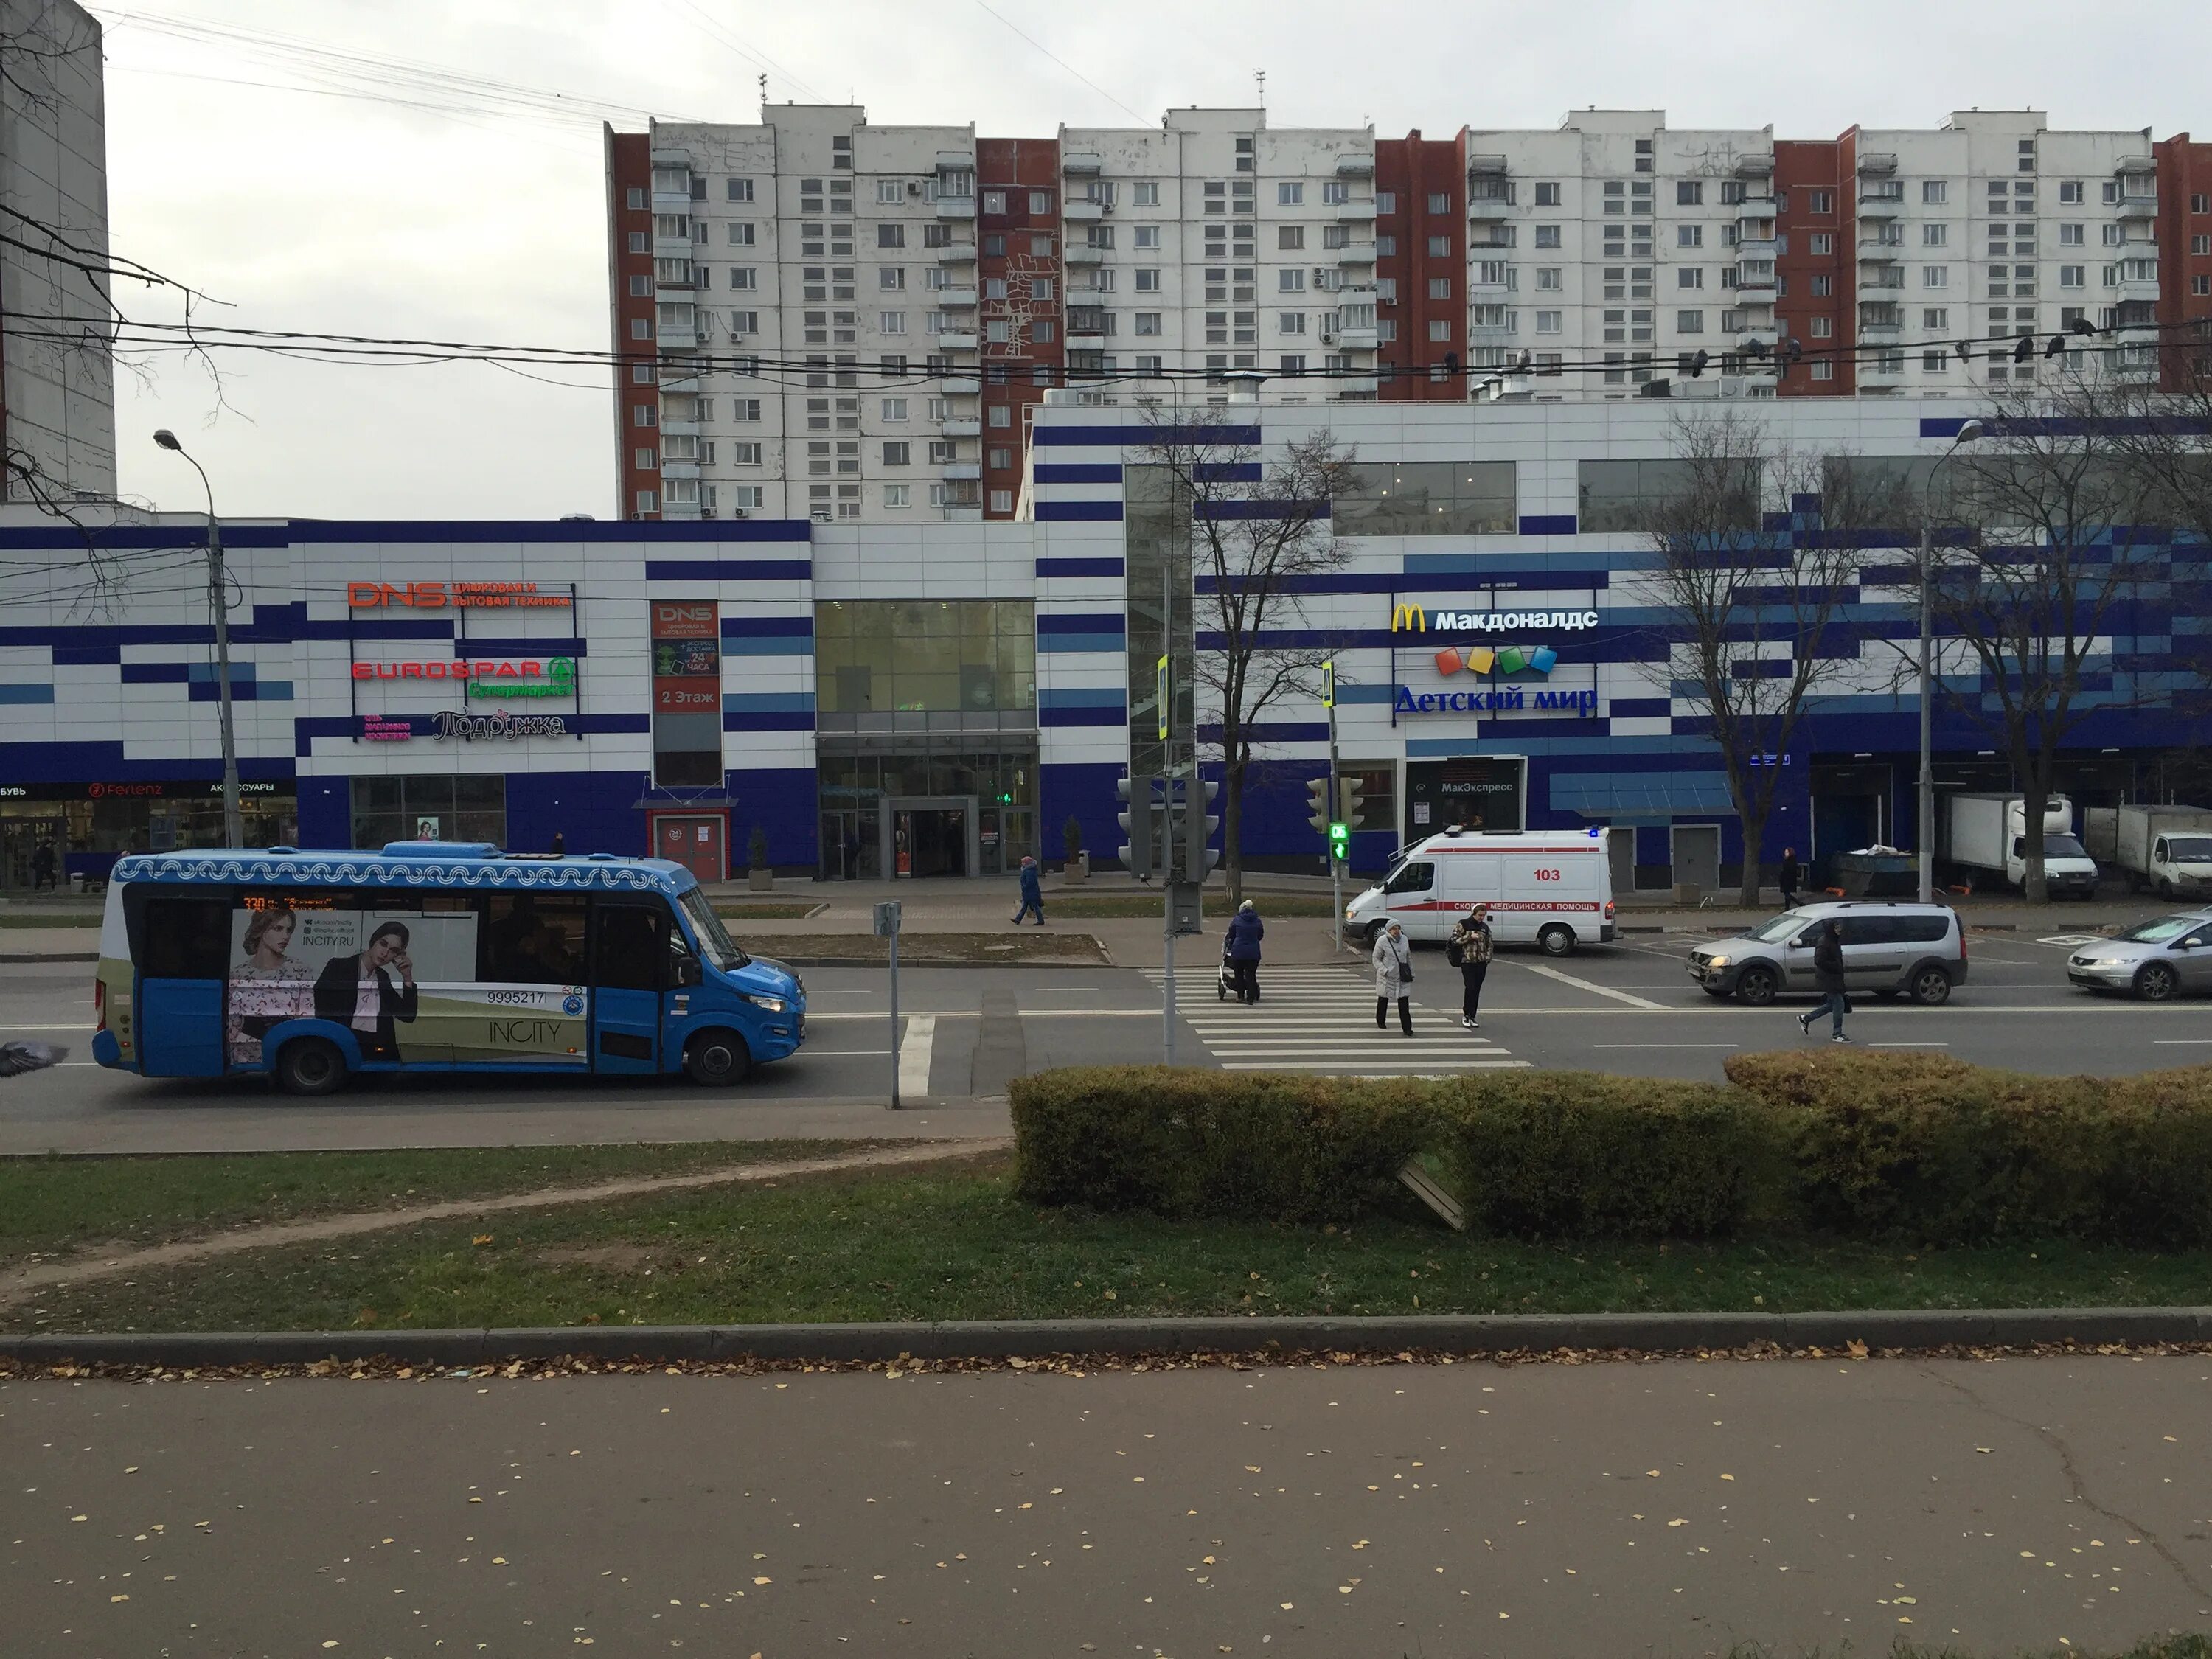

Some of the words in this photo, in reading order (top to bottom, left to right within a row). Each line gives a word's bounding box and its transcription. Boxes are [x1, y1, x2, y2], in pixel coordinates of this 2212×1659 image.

[452, 582, 523, 594] ЦИФРОВАЯ
[527, 583, 538, 593] И
[348, 582, 447, 607] DNS
[452, 596, 509, 606] БЫТОВАЯ
[515, 597, 571, 606] ТЕХНИКА
[659, 607, 712, 621] DNS
[1435, 611, 1599, 632] Макдоналдс
[692, 653, 706, 663] 24
[353, 662, 541, 679] EUROSPAR
[469, 682, 574, 699] Супермаркет
[662, 691, 671, 703] 2
[675, 690, 714, 703] Этаж
[1395, 685, 1523, 713] Детский
[1533, 689, 1599, 717] мир
[432, 706, 566, 742] Подружка
[108, 784, 163, 796] Ferlenz
[210, 783, 274, 792] АКССУАРЫ
[1441, 783, 1513, 793] МакЭкспресс
[1534, 869, 1560, 881] 103
[1490, 902, 1552, 911] МЕДИЦИНСКАЯ
[1557, 902, 1596, 911] ПОМОЩЬ
[487, 992, 545, 1004] 9995217
[490, 1020, 562, 1043] INCITY
